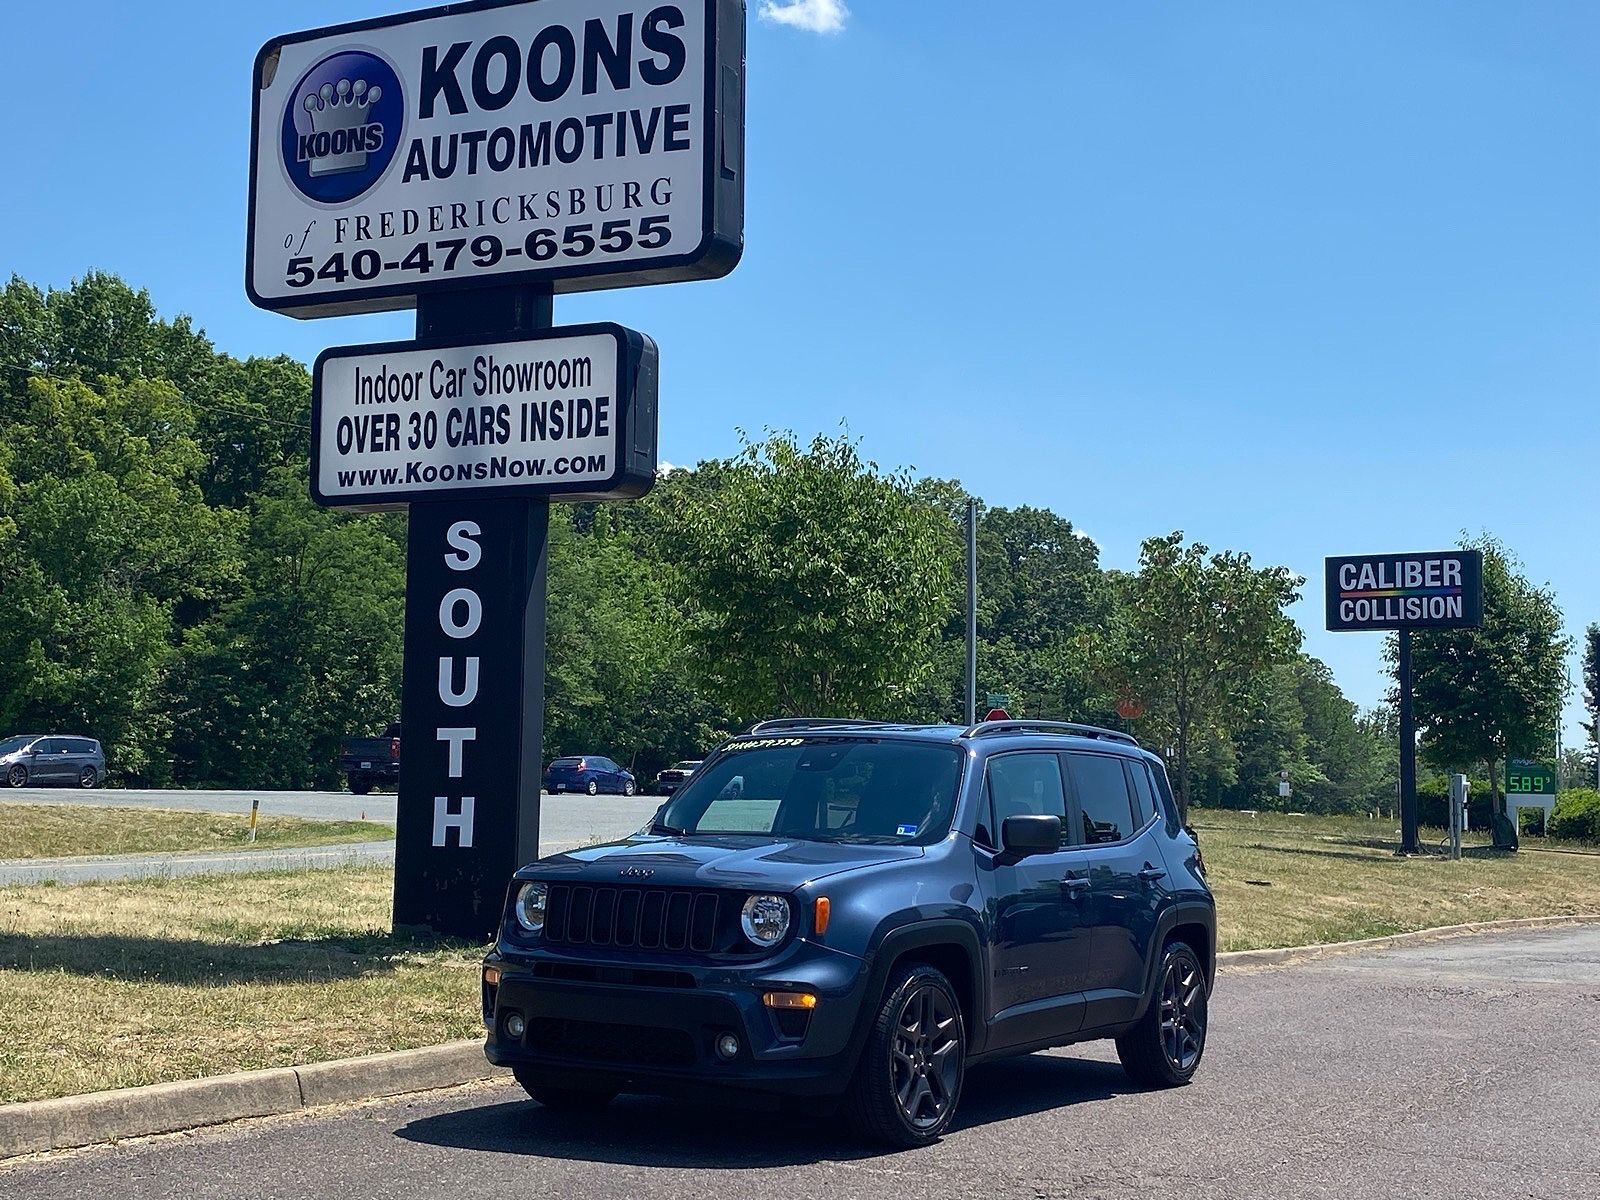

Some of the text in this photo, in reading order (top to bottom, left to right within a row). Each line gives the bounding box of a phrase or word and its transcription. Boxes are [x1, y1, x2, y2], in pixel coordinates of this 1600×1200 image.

[418, 5, 686, 120] KOONS
[298, 122, 384, 162] KOONS
[402, 104, 691, 184] AUTOMOTIVE
[284, 177, 674, 257] of FREDERICKSBURG
[285, 215, 672, 288] 540-479-6555
[355, 354, 591, 405] Indoor Car Showroom
[336, 396, 610, 456] OVER 30 CARS INSIDE
[1339, 559, 1462, 590] CALIBER
[1339, 596, 1463, 622] COLLISION
[432, 520, 482, 847] SOUTH
[619, 865, 655, 881] Jeep
